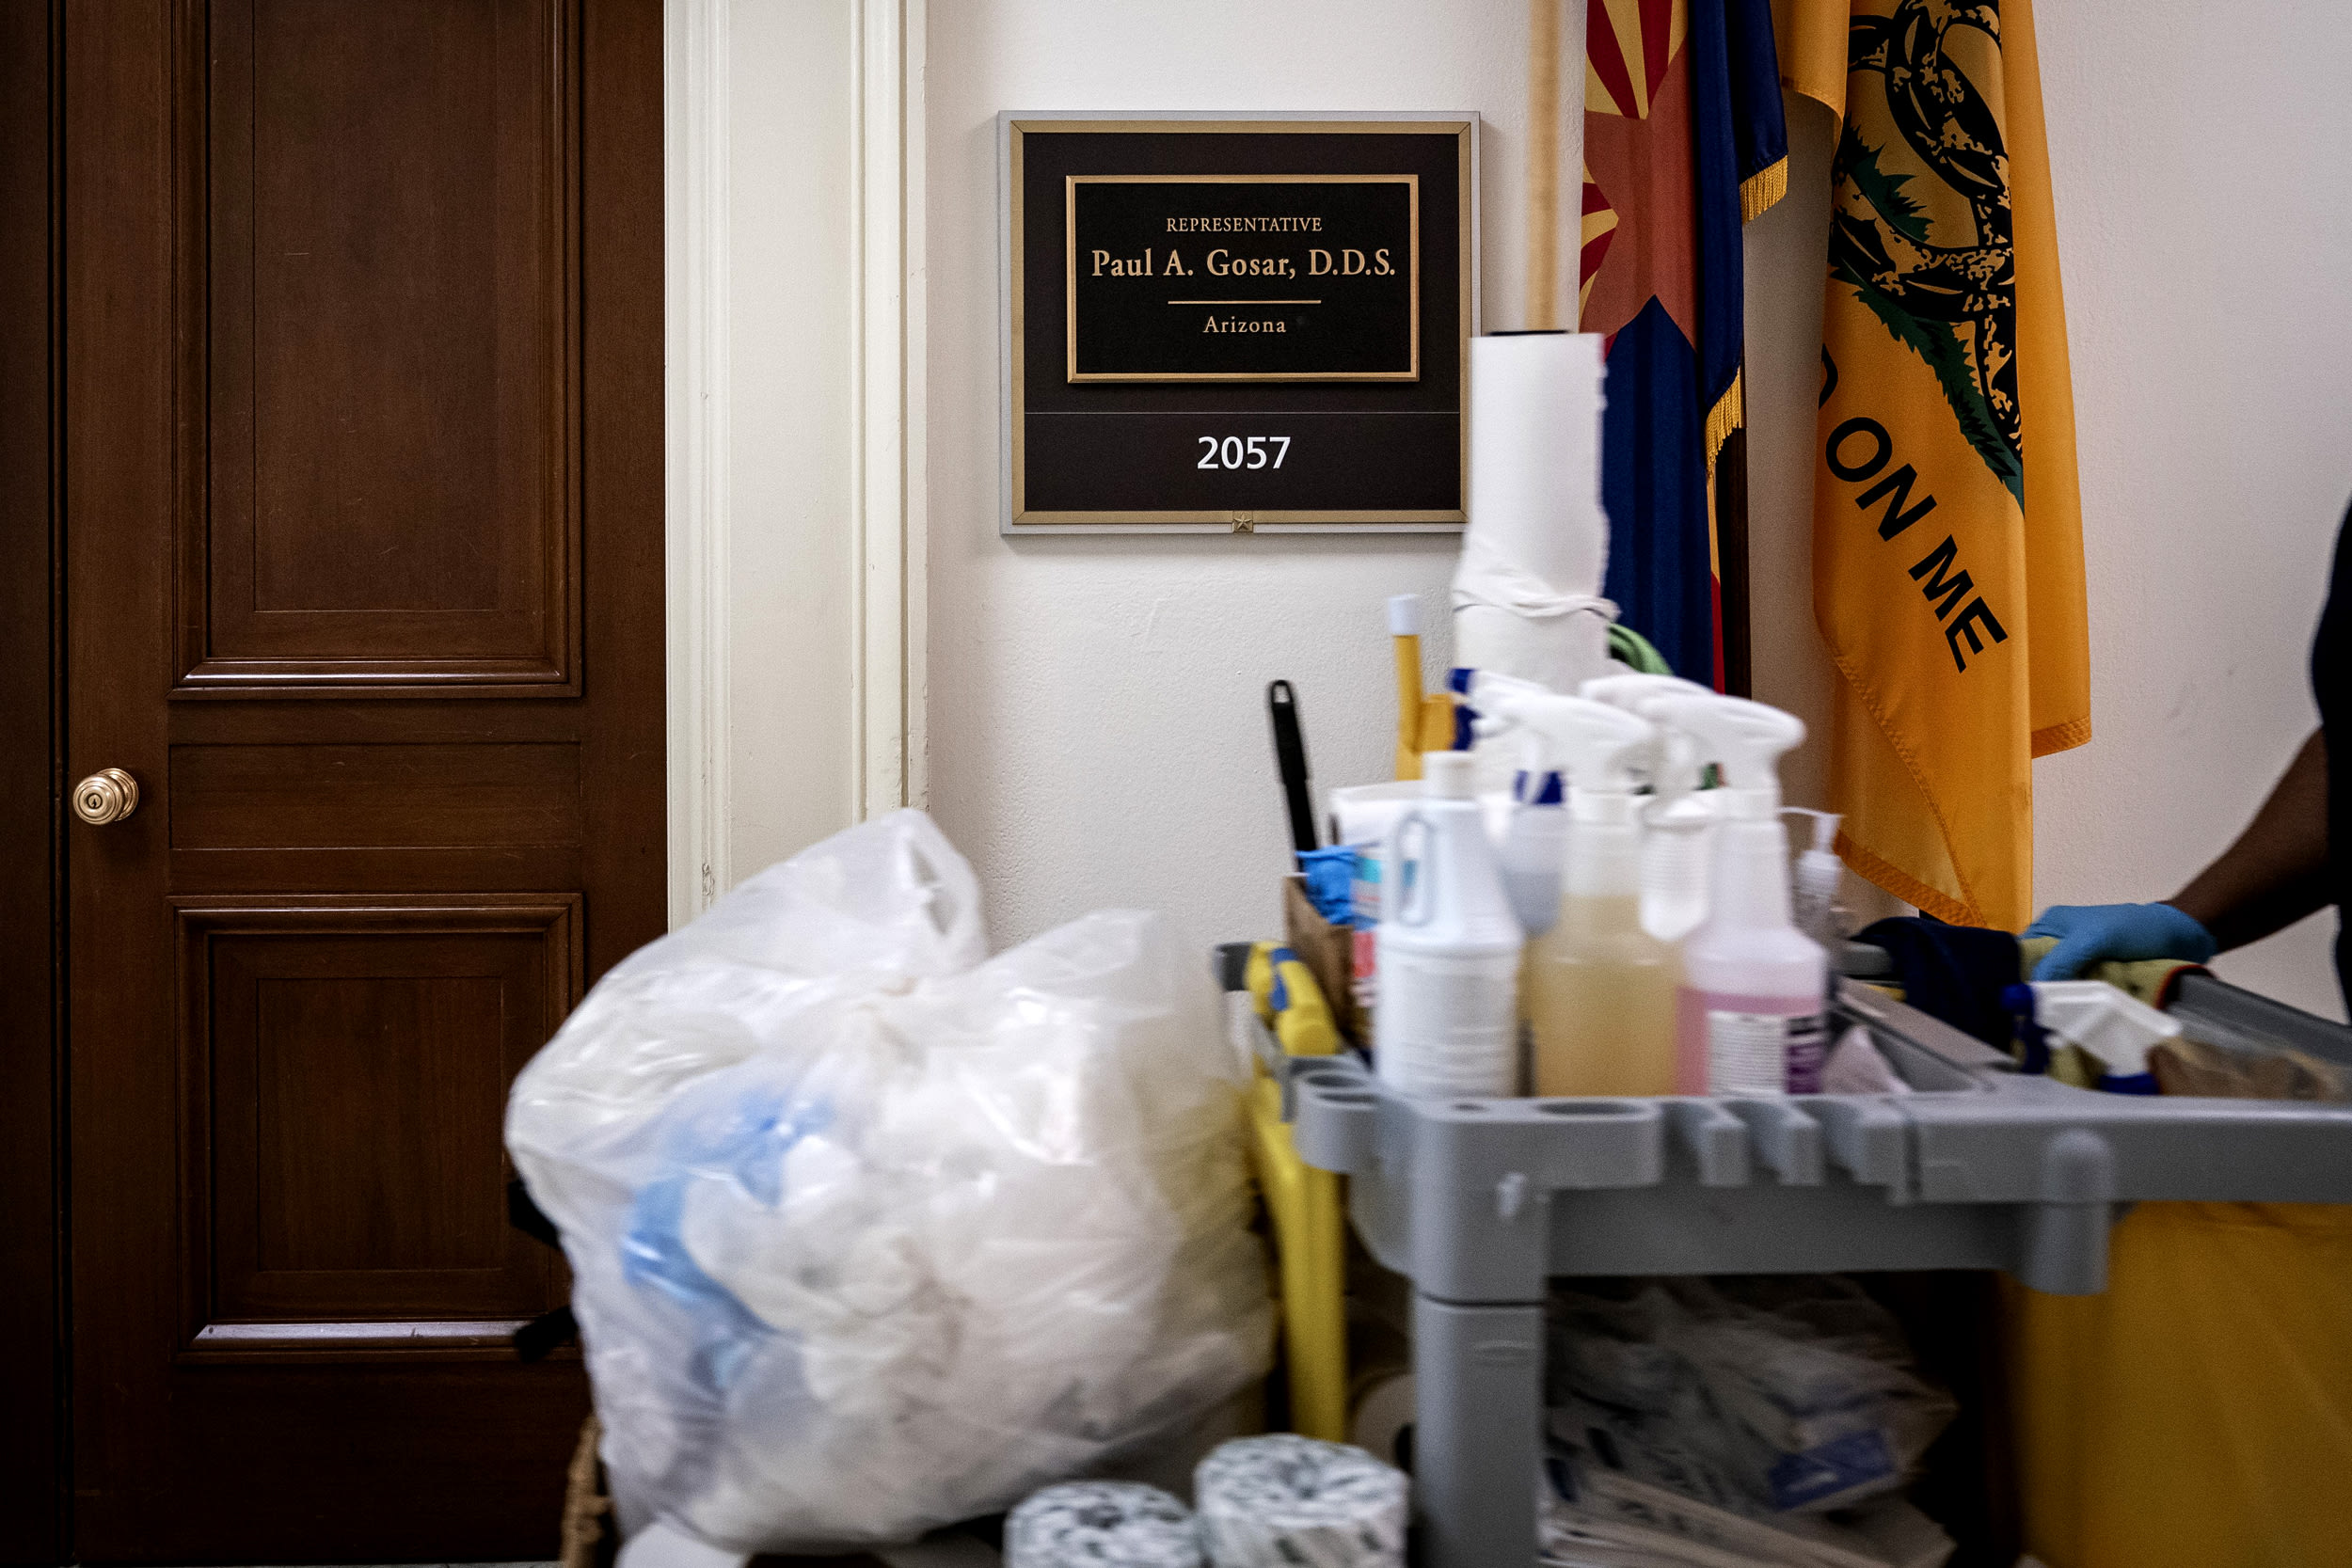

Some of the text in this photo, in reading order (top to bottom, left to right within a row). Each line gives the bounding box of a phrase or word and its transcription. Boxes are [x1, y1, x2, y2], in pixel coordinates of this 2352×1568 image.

[1166, 217, 1323, 232] REPRESENTATIVE
[1091, 247, 1396, 279] Paul A. Gosar, D.D.S.
[1202, 315, 1287, 333] Arizona
[1197, 436, 1292, 469] 2057
[1825, 417, 2009, 673] ON ME
